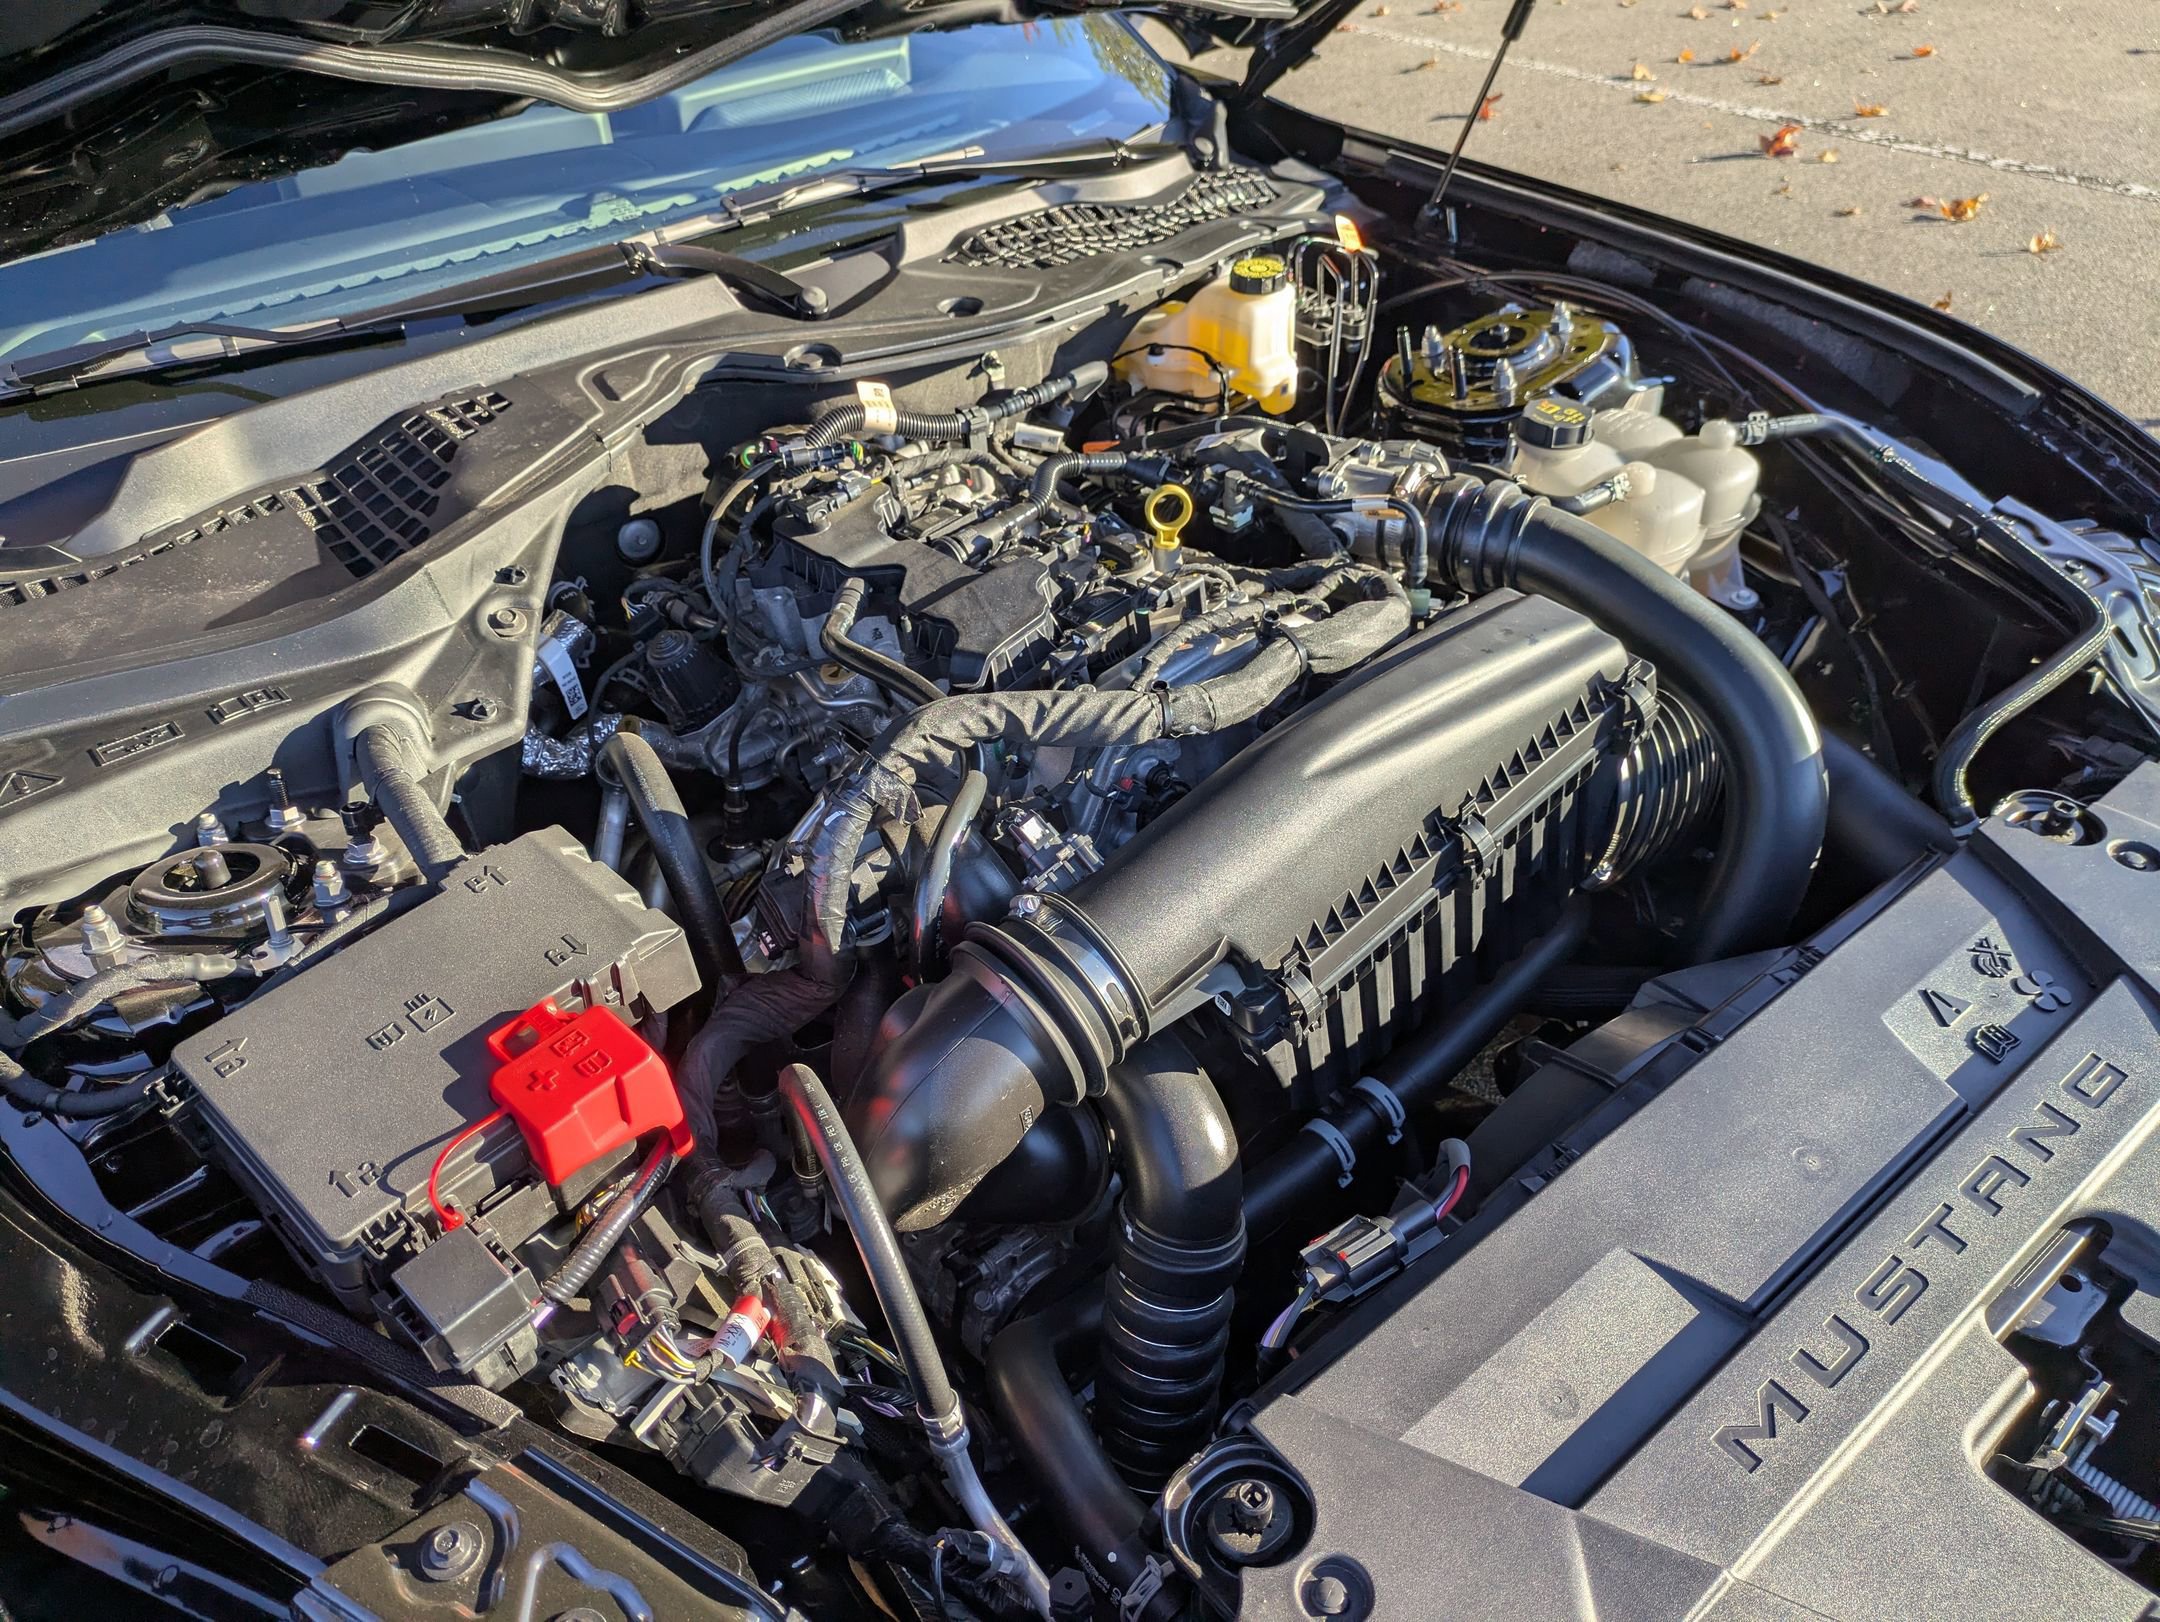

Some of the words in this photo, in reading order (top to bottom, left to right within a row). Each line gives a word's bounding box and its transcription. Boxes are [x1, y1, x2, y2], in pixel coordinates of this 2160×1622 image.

[825, 1125, 837, 1137] PET
[833, 1141, 843, 1152] CR
[841, 1156, 852, 1168] PA
[1711, 1052, 2128, 1473] MUSTANG
